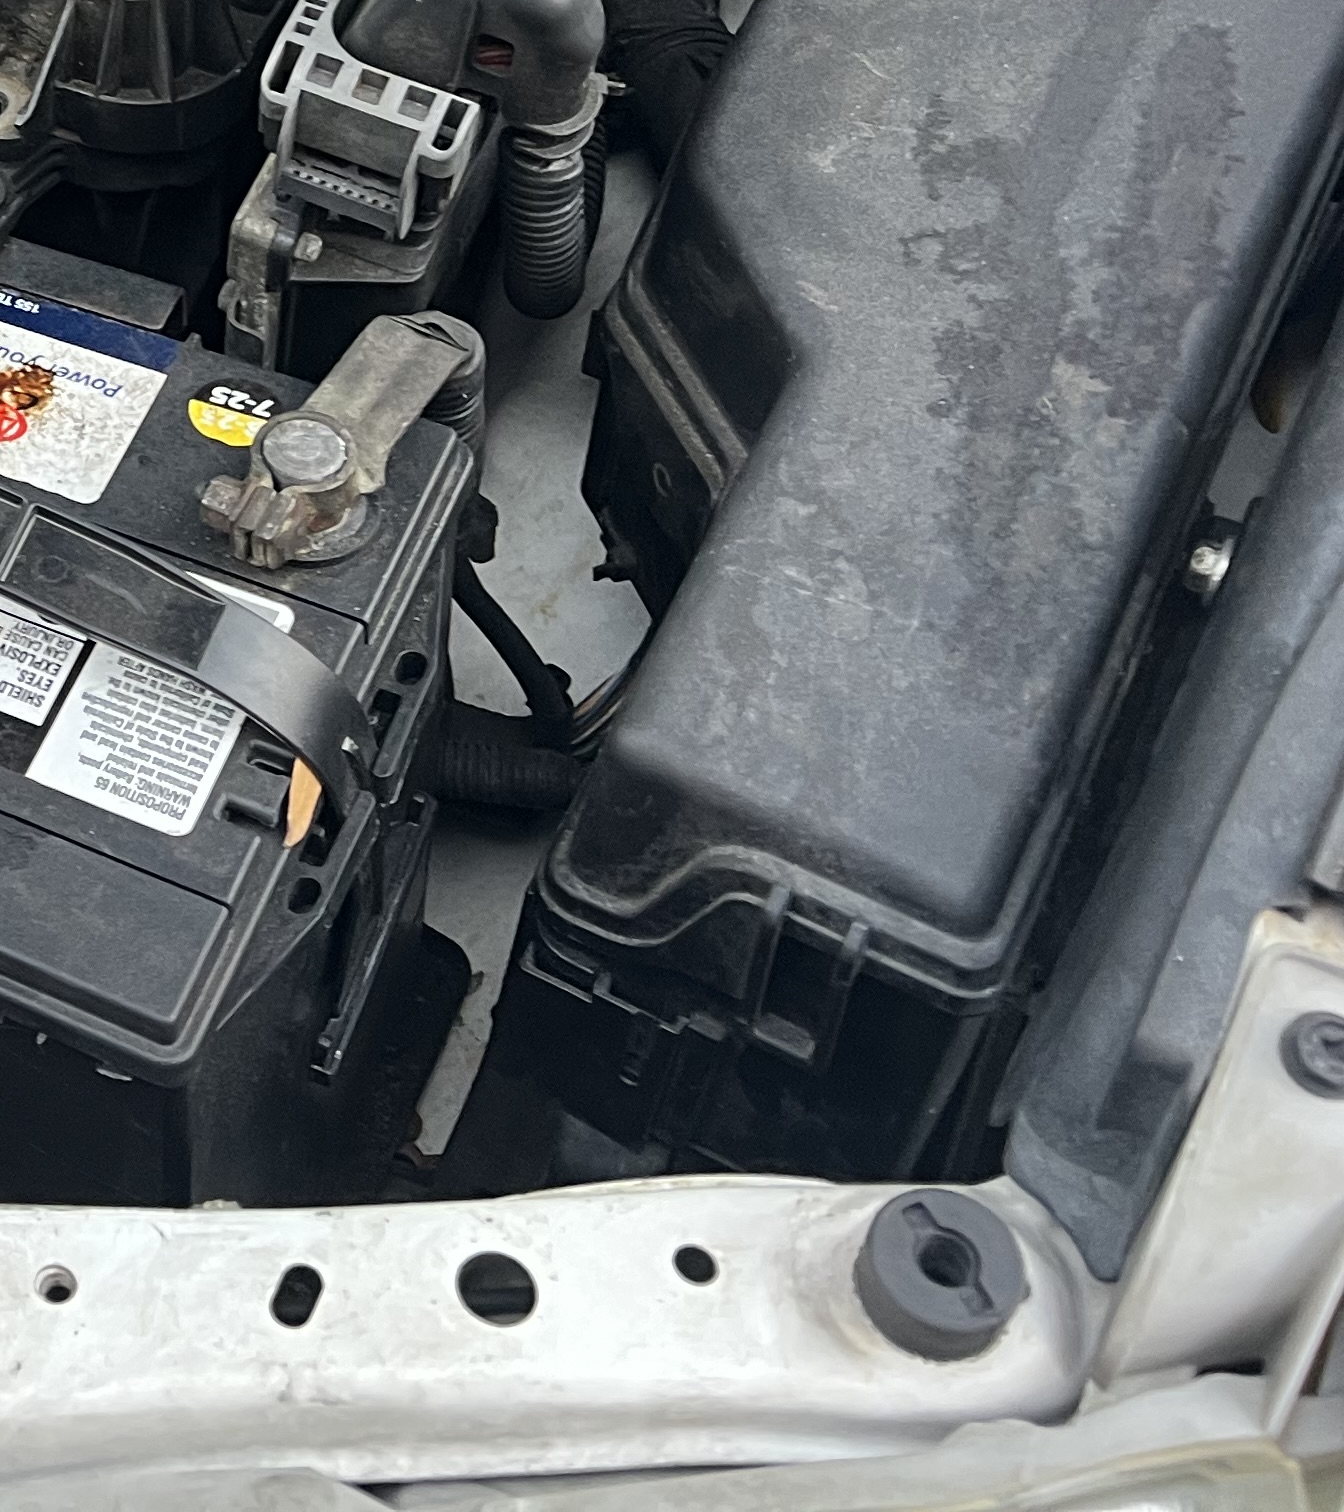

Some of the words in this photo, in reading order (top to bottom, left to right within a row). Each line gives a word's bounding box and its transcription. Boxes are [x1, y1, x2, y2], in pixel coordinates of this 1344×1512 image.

[14, 298, 40, 313] 155
[208, 383, 275, 417] 7-25
[3, 629, 42, 651] CAUSE
[56, 637, 74, 650] OR
[43, 644, 68, 661] CAN
[11, 667, 53, 692] EYES.
[93, 776, 110, 790] 65
[134, 776, 192, 807] WARNING:
[108, 780, 186, 821] PROPOSITION
